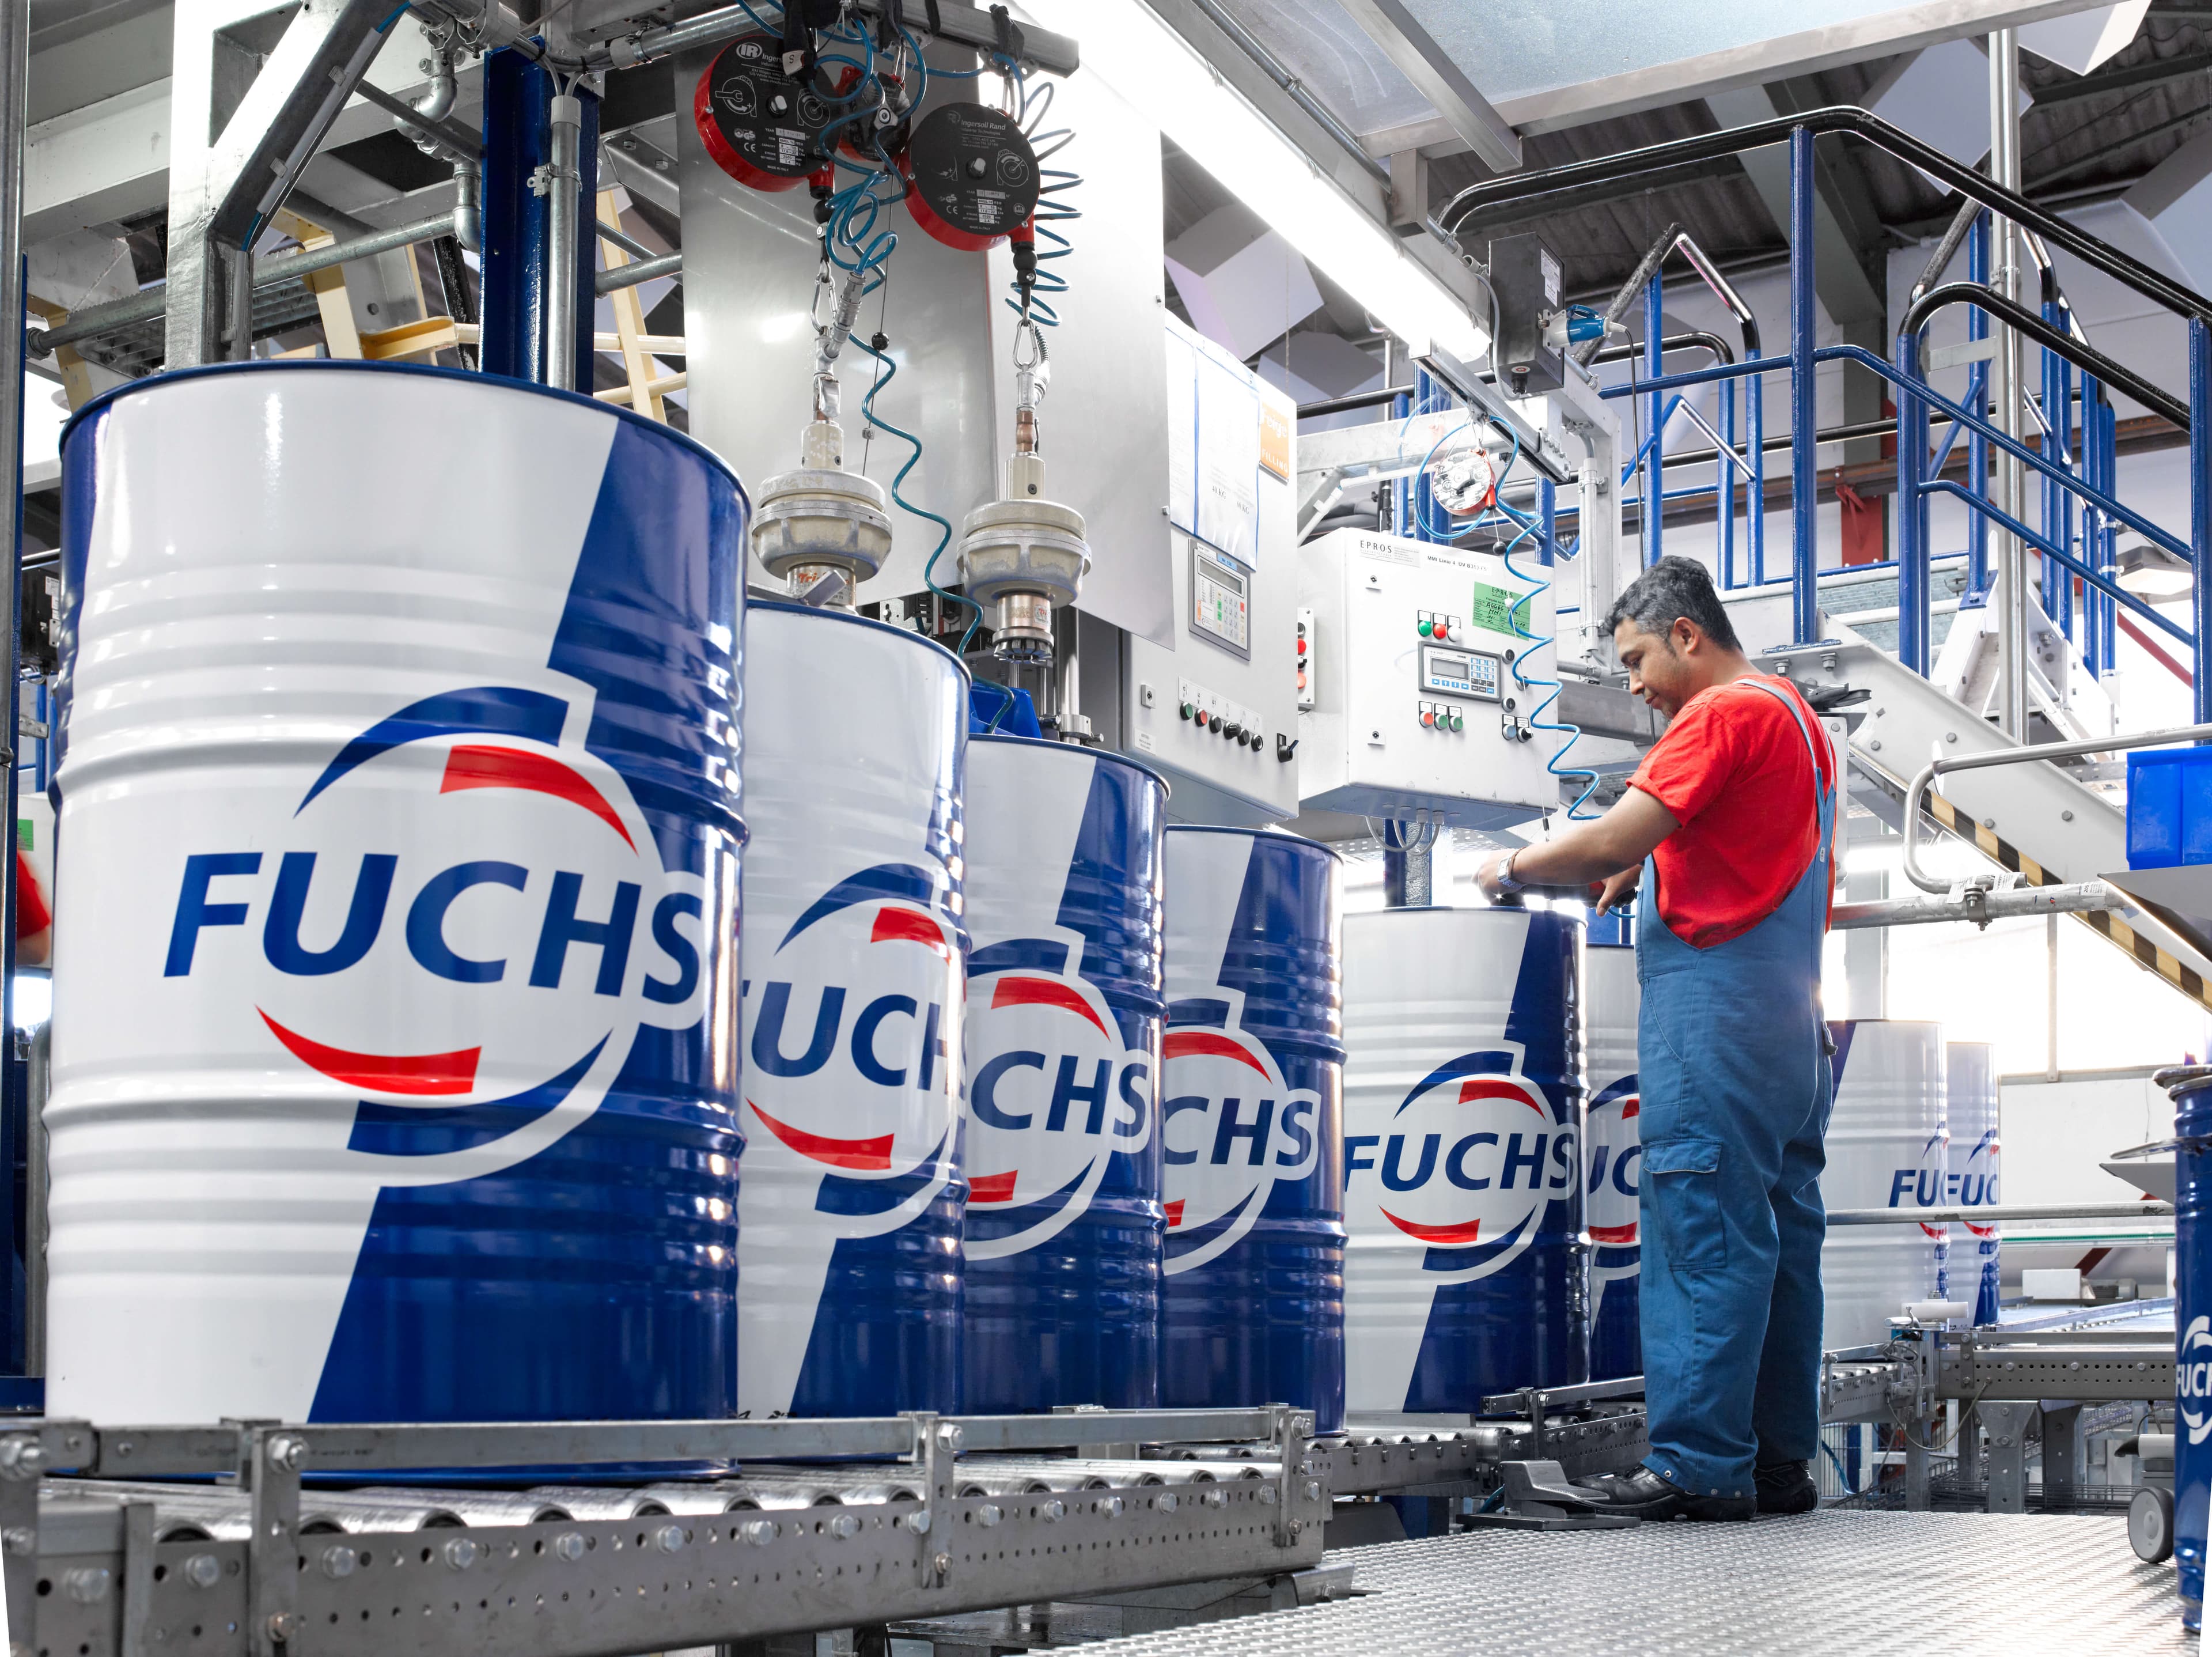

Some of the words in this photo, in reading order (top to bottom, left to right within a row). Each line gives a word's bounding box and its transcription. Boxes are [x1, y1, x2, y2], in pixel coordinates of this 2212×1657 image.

[789, 54, 794, 63] S
[961, 119, 988, 128] Ingersoll
[990, 122, 1006, 130] Rand
[1259, 408, 1287, 438] Feige
[1262, 448, 1288, 473] FILLING
[164, 852, 703, 1005] FUCHS
[743, 980, 967, 1100] UCH
[971, 1051, 1147, 1137] CHS
[1164, 1096, 1313, 1167] CHS
[1344, 1132, 1574, 1192] FUCHS
[1948, 1174, 1997, 1206] FUC
